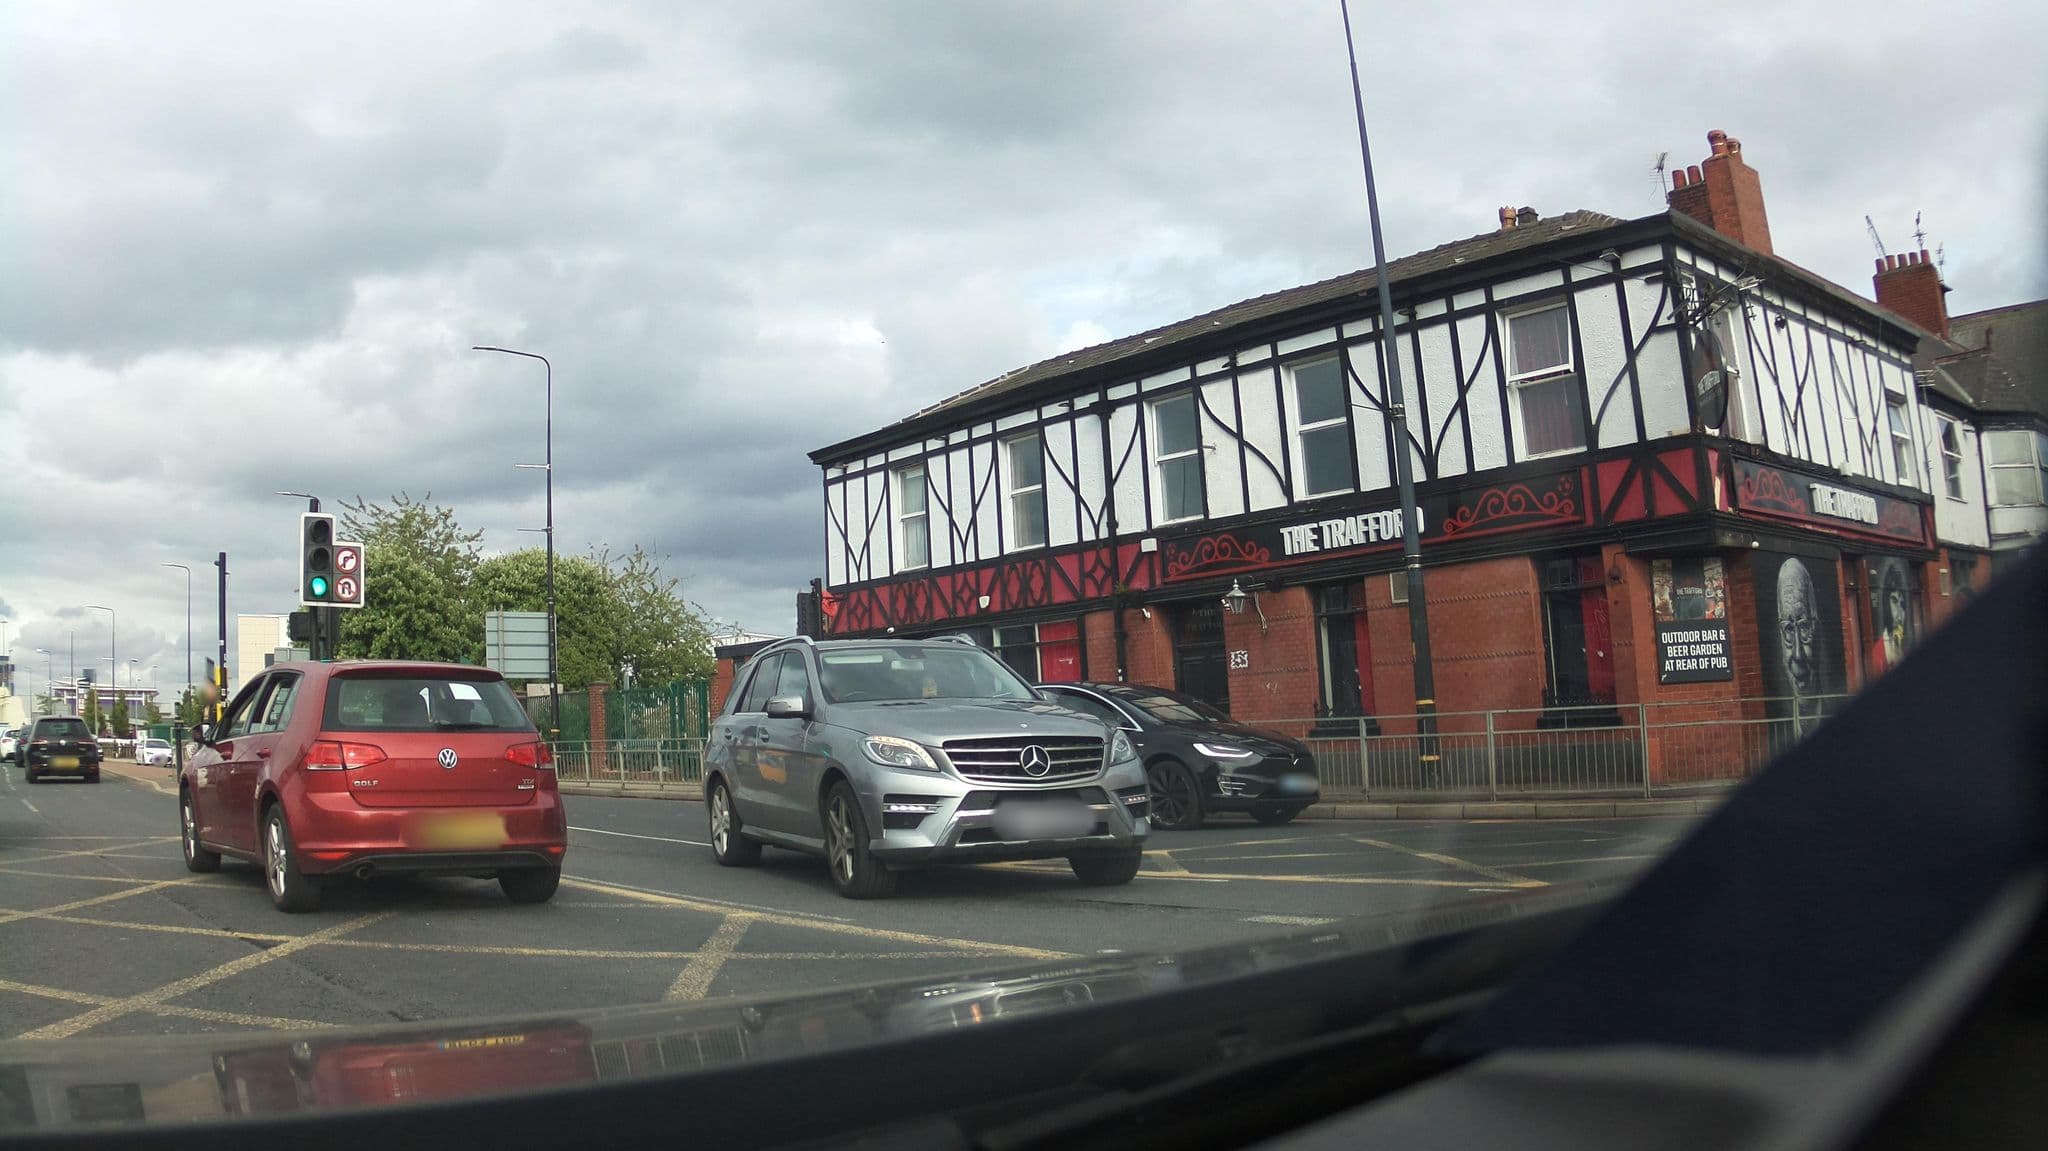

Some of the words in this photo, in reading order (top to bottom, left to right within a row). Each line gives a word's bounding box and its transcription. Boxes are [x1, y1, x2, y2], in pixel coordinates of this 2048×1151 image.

[1280, 523, 1320, 556] THE
[1661, 631, 1701, 644] OUTDOOR
[1702, 630, 1718, 642] BAR
[1719, 629, 1726, 641] &
[1667, 645, 1689, 657] BEER
[1690, 643, 1722, 656] GARDEN
[1665, 660, 1675, 672] AT
[1676, 658, 1698, 671] REAR
[1699, 658, 1710, 670] OF
[1711, 656, 1728, 669] PUB
